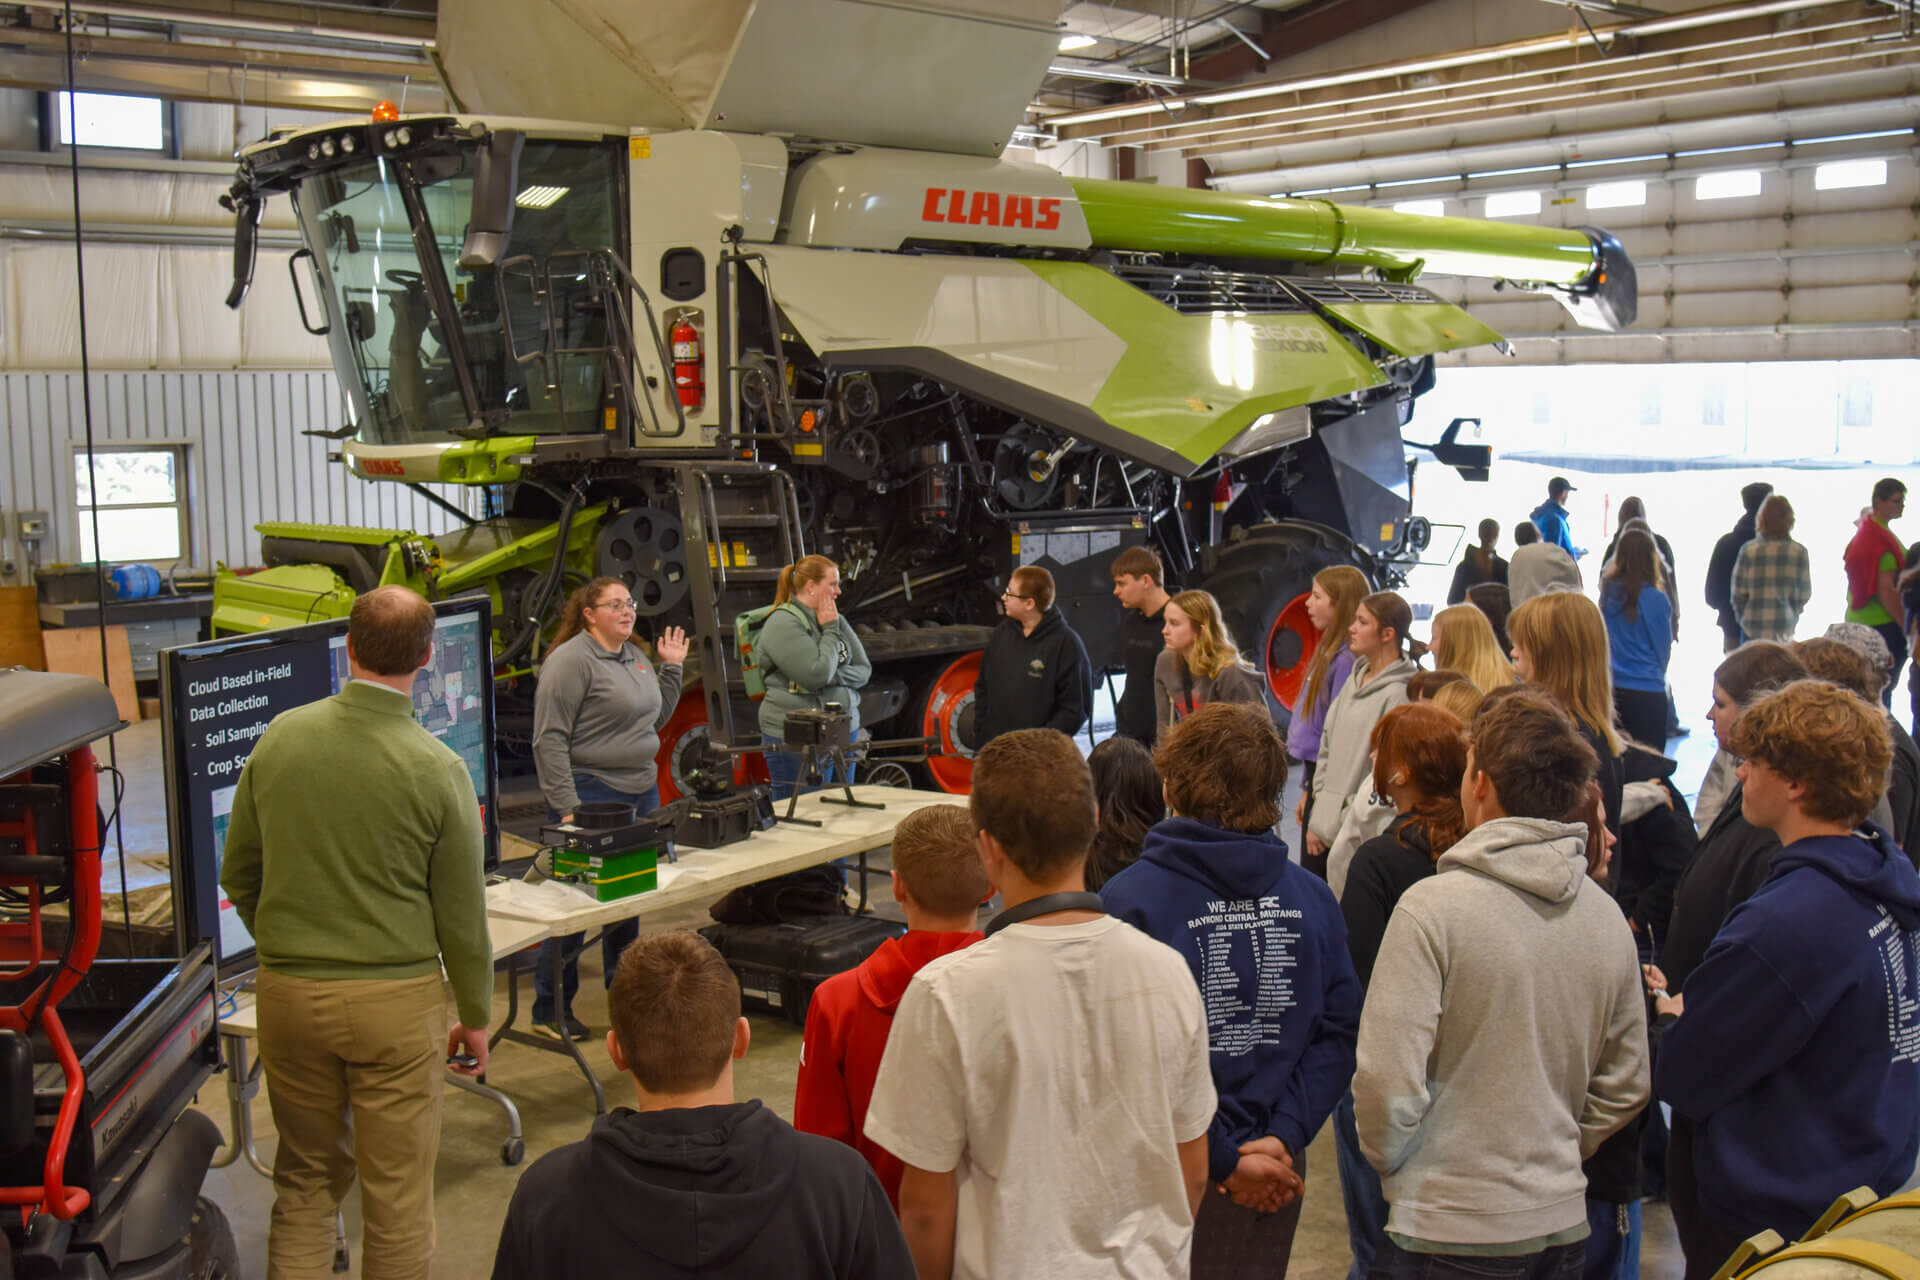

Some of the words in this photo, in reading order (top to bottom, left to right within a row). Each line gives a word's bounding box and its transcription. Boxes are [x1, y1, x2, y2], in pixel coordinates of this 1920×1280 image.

[922, 187, 1061, 230] CLAAS
[188, 677, 219, 697] Cloud
[222, 670, 253, 690] Based
[255, 663, 292, 683] in-Field
[190, 707, 216, 722] Data
[218, 694, 269, 716] Collection
[205, 730, 226, 748] Soil
[227, 721, 270, 742] Samplin
[207, 761, 233, 776] Crop
[1187, 915, 1223, 929] RAYMOND
[1224, 912, 1258, 923] CENTRAL
[1260, 909, 1302, 920] MUSTANGS
[1207, 901, 1226, 913] WE
[1228, 900, 1255, 912] ARE
[102, 1096, 138, 1149] Kawasaki
